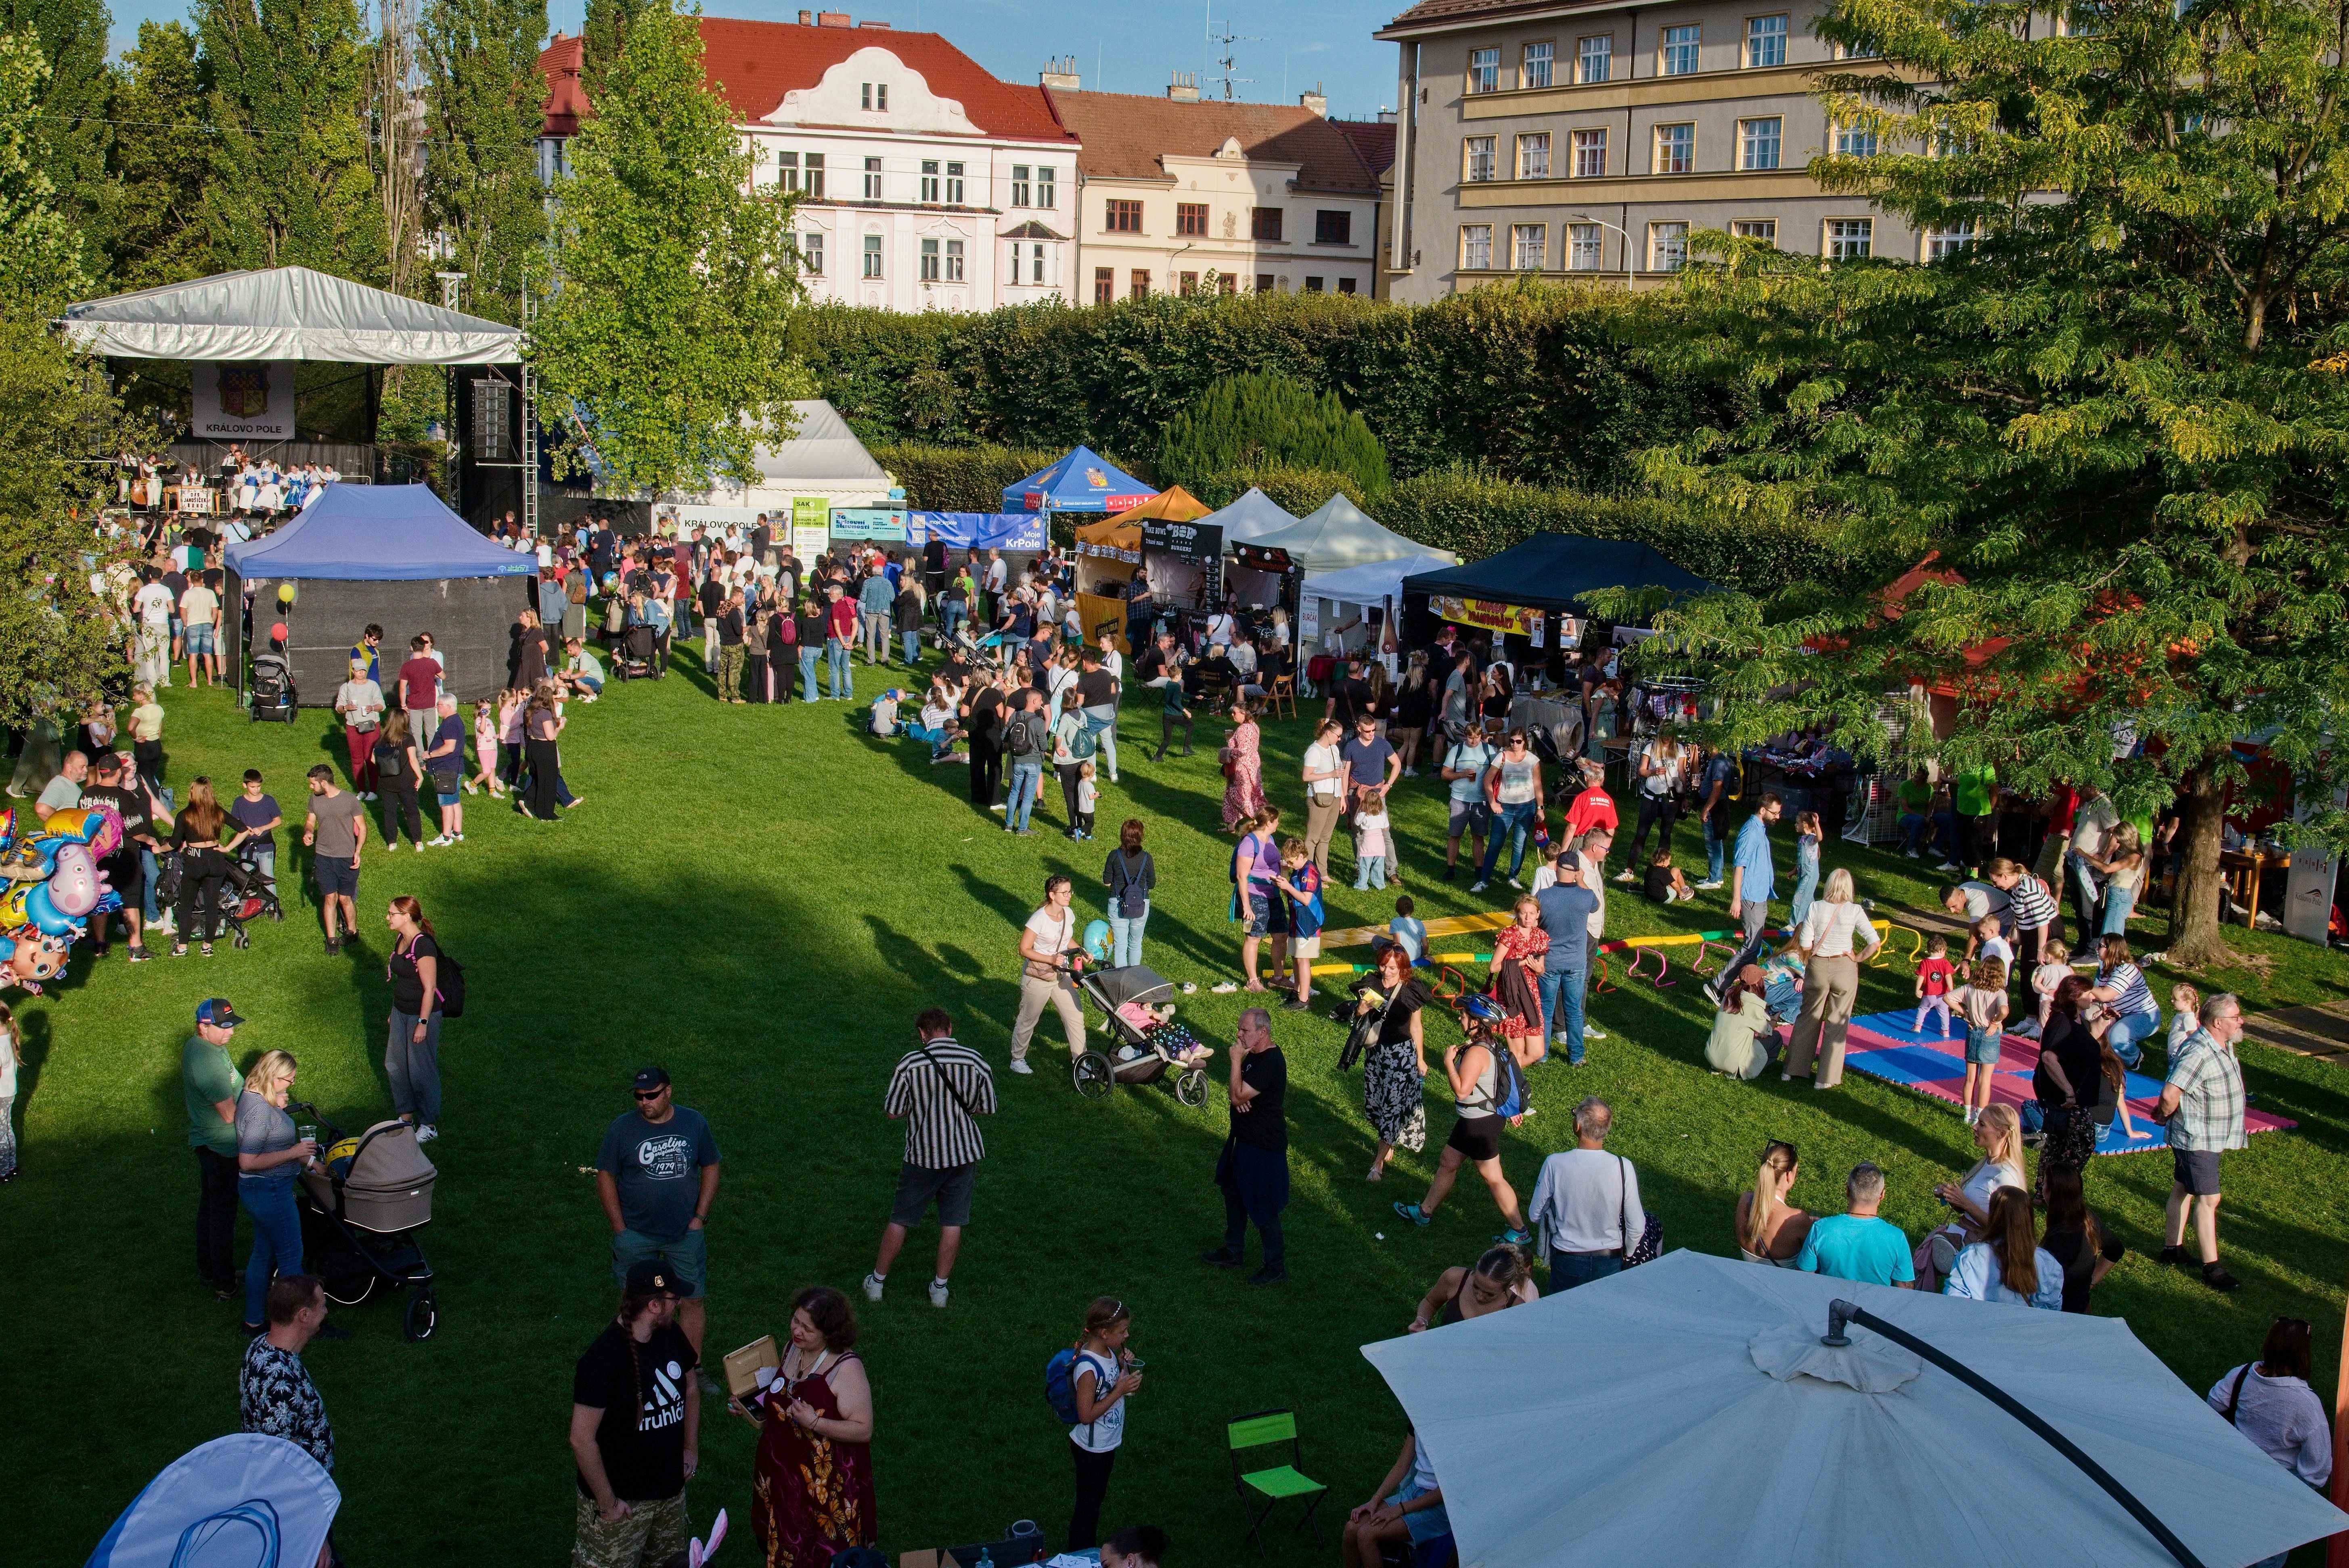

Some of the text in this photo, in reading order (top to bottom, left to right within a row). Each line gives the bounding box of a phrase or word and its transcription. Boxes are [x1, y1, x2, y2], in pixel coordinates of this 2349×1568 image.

[206, 423, 253, 433] KRÁLOVO
[685, 519, 729, 528] KRÁLOVO
[1155, 527, 1166, 535] BOWL
[1172, 525, 1193, 540] BOB
[1006, 538, 1041, 548] KrPole
[1302, 612, 1317, 622] BURČÁK
[188, 846, 201, 857] GIN
[2295, 892, 2322, 906] Královo Pole
[639, 1137, 687, 1164] Gasoline
[655, 1146, 676, 1157] original
[656, 1162, 675, 1171] 1979
